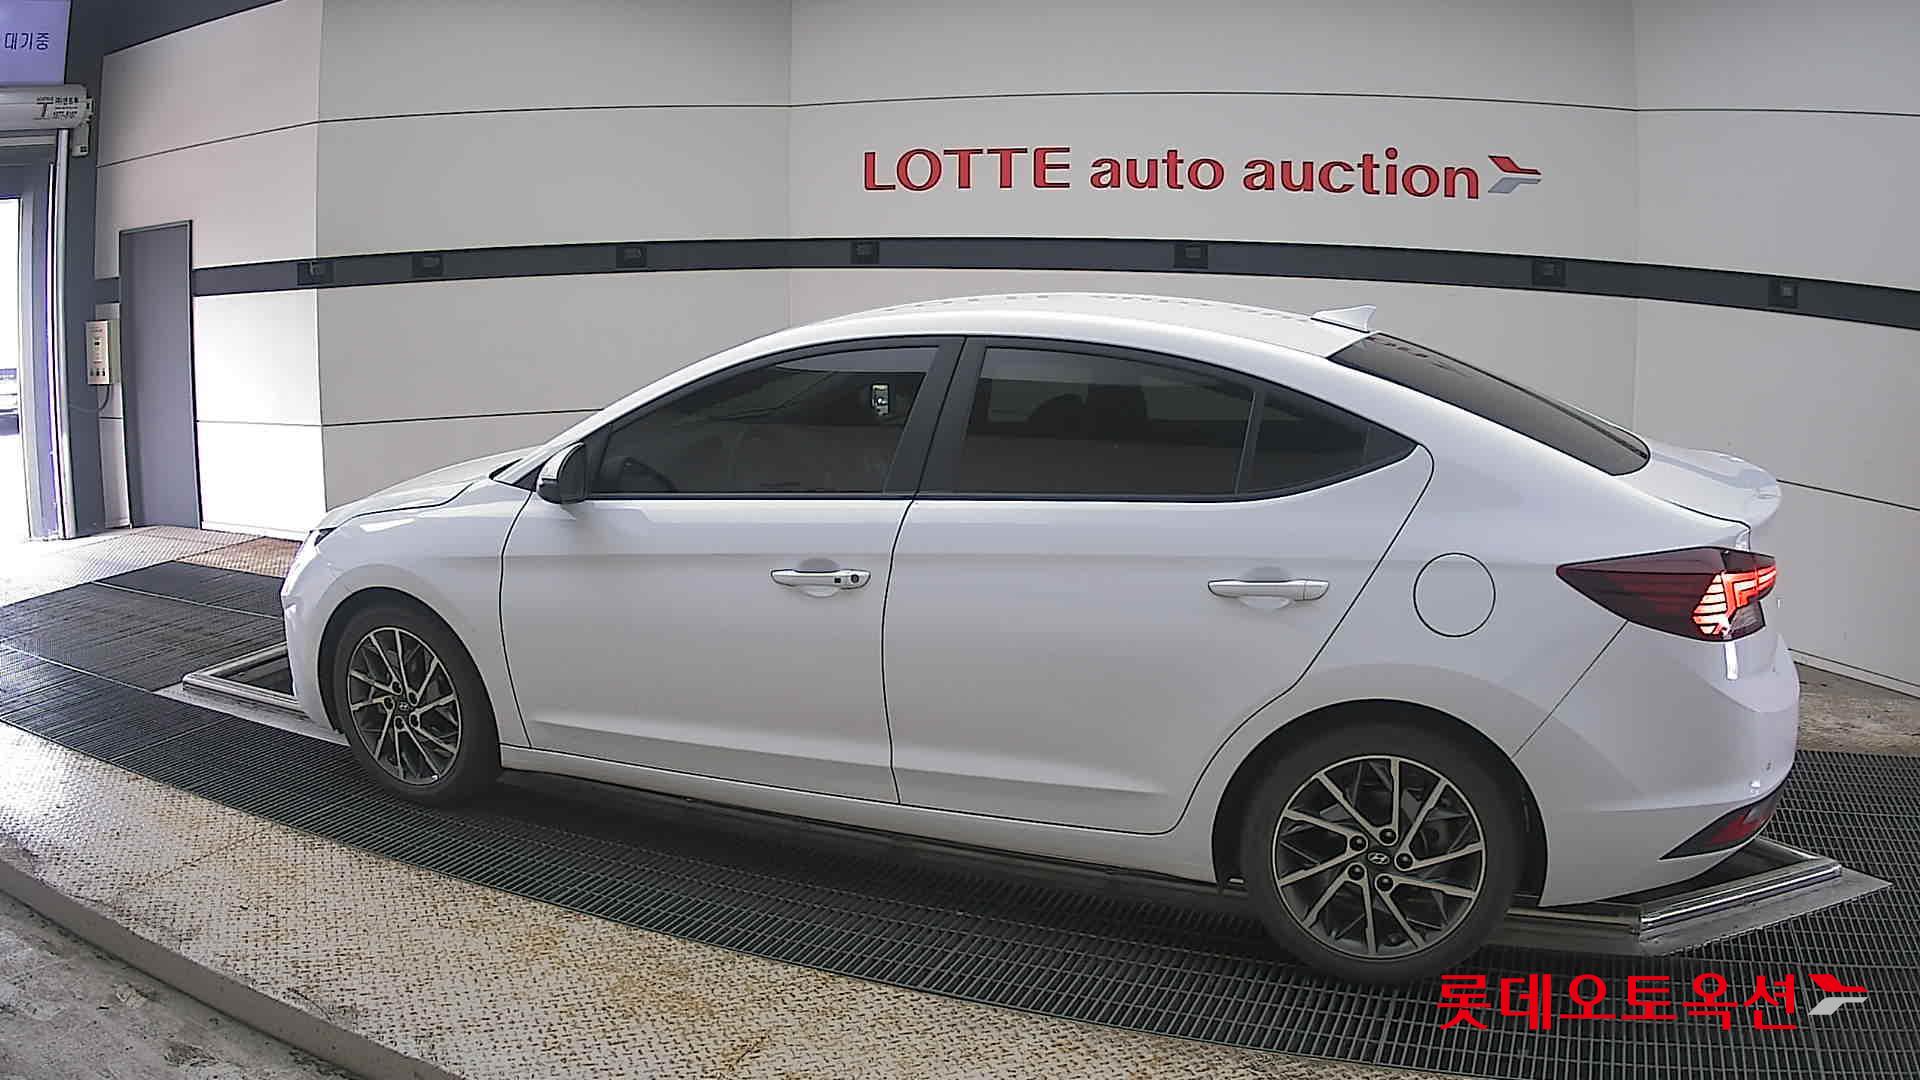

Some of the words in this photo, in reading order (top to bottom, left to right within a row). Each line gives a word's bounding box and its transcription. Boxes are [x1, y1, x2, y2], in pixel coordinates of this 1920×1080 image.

[4, 32, 49, 50] 대기중
[863, 146, 1071, 191] LOTTE
[1090, 149, 1225, 191] auto
[1242, 147, 1481, 200] auction
